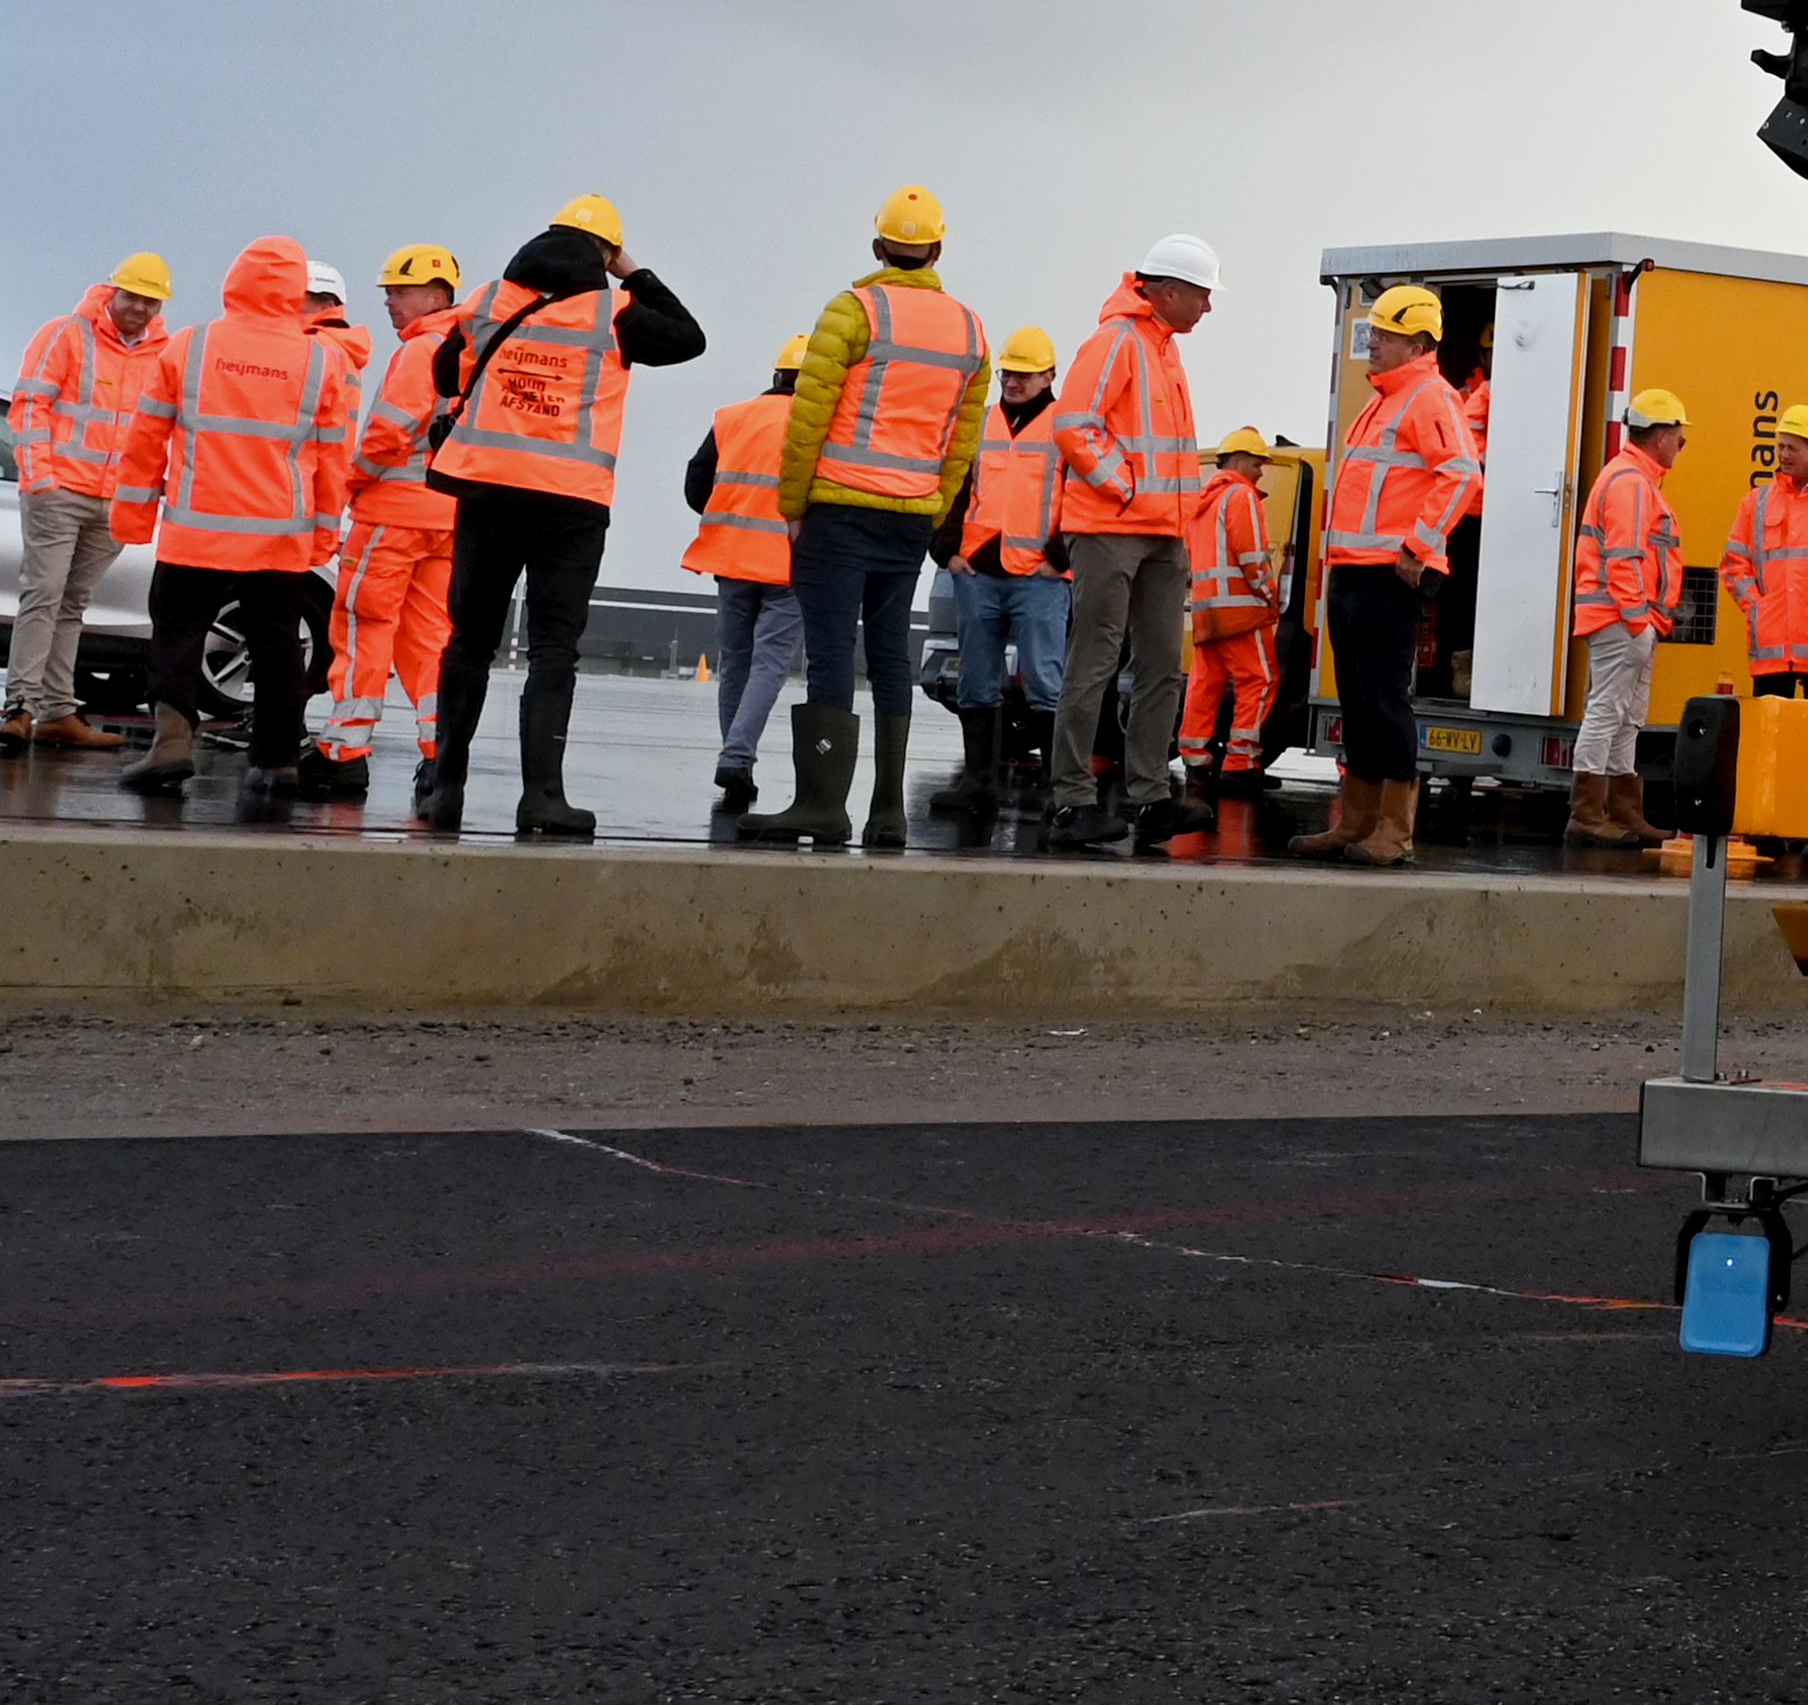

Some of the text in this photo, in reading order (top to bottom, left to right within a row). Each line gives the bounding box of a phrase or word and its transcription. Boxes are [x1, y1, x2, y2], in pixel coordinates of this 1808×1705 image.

[499, 347, 568, 368] heijmans
[215, 357, 289, 381] heijmans
[499, 395, 560, 417] AFSTAND
